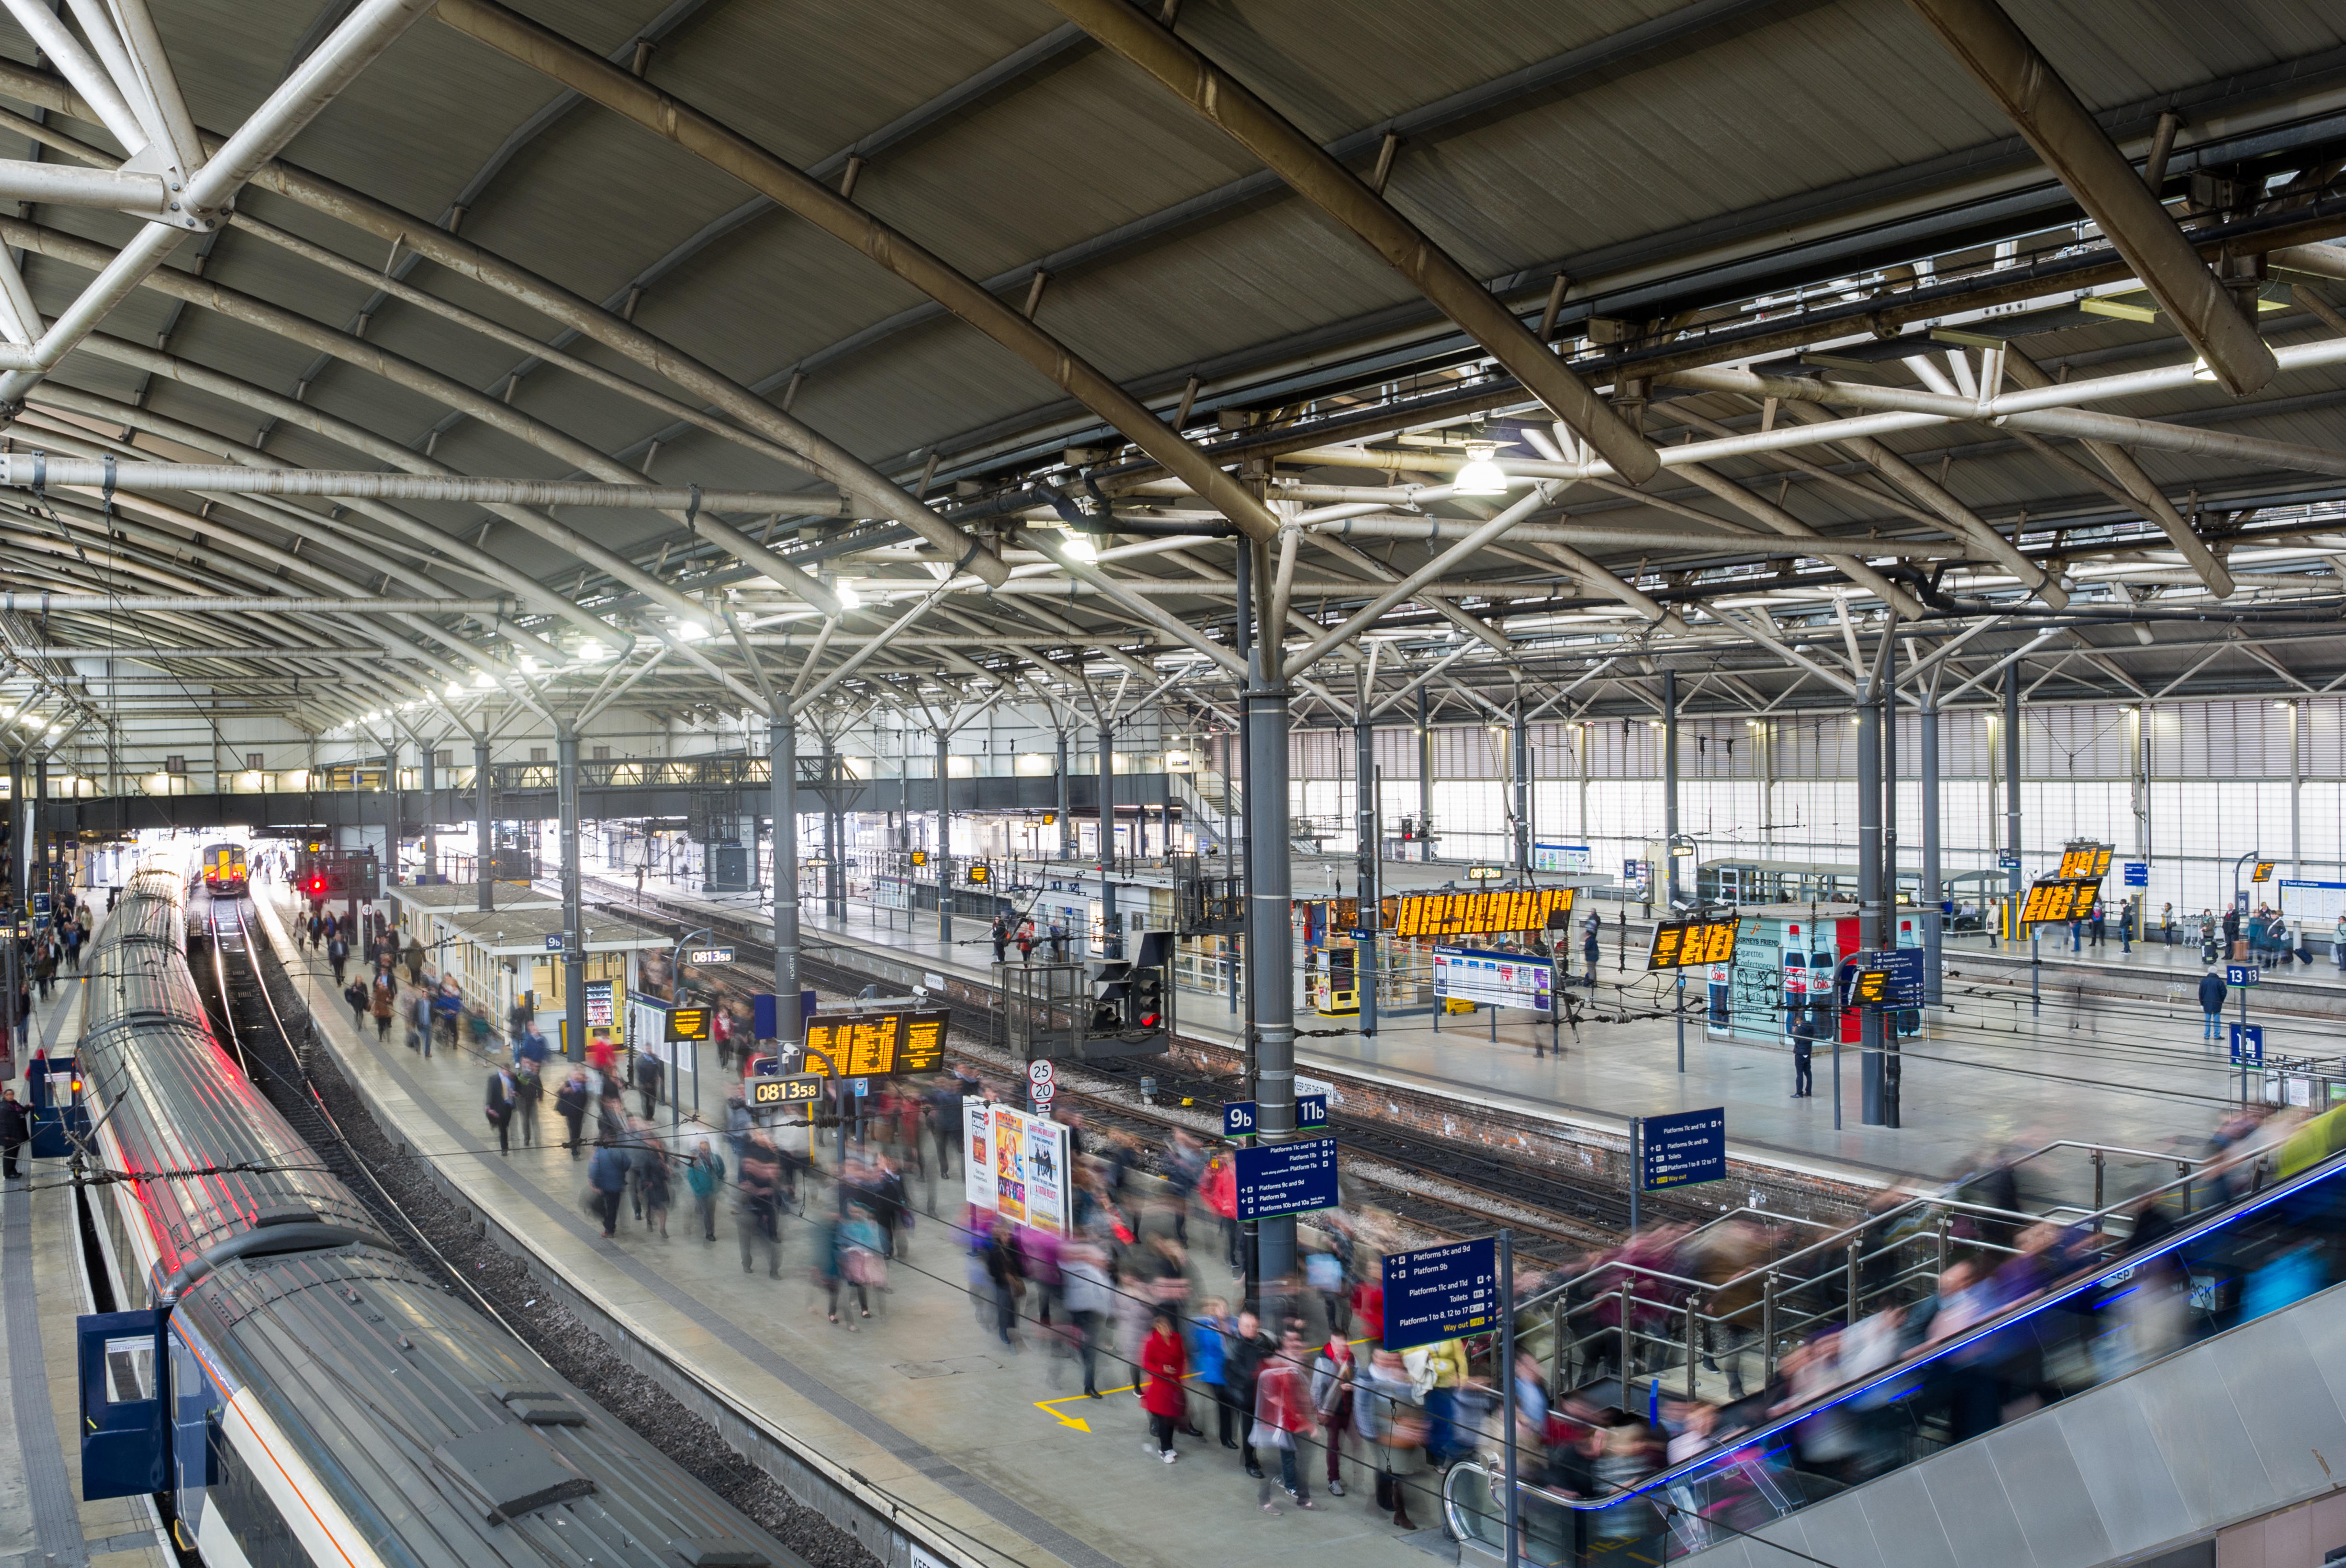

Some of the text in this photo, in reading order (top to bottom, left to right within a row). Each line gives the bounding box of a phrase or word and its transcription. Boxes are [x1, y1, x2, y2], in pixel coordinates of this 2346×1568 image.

[548, 937, 560, 946] 9b
[1736, 947, 1764, 957] Cigarettes
[1736, 958, 1776, 970] Confectionery
[1711, 968, 1725, 981] Coke
[2230, 970, 2243, 982] 13
[2247, 970, 2257, 982] 13
[1034, 1065, 1048, 1078] 25
[1036, 1084, 1050, 1096] 20
[1294, 1081, 1304, 1091] KEEP
[1301, 1101, 1324, 1120] 11b
[1231, 1108, 1252, 1128] 9b
[973, 1126, 985, 1140] RYAN
[1414, 1252, 1441, 1261] Platforms
[1451, 1246, 1461, 1255] and
[1414, 1267, 1438, 1275] Platform
[1409, 1287, 1437, 1296] Platforms
[1450, 1294, 1468, 1303] Toilets
[1400, 1315, 1428, 1326] Platforms
